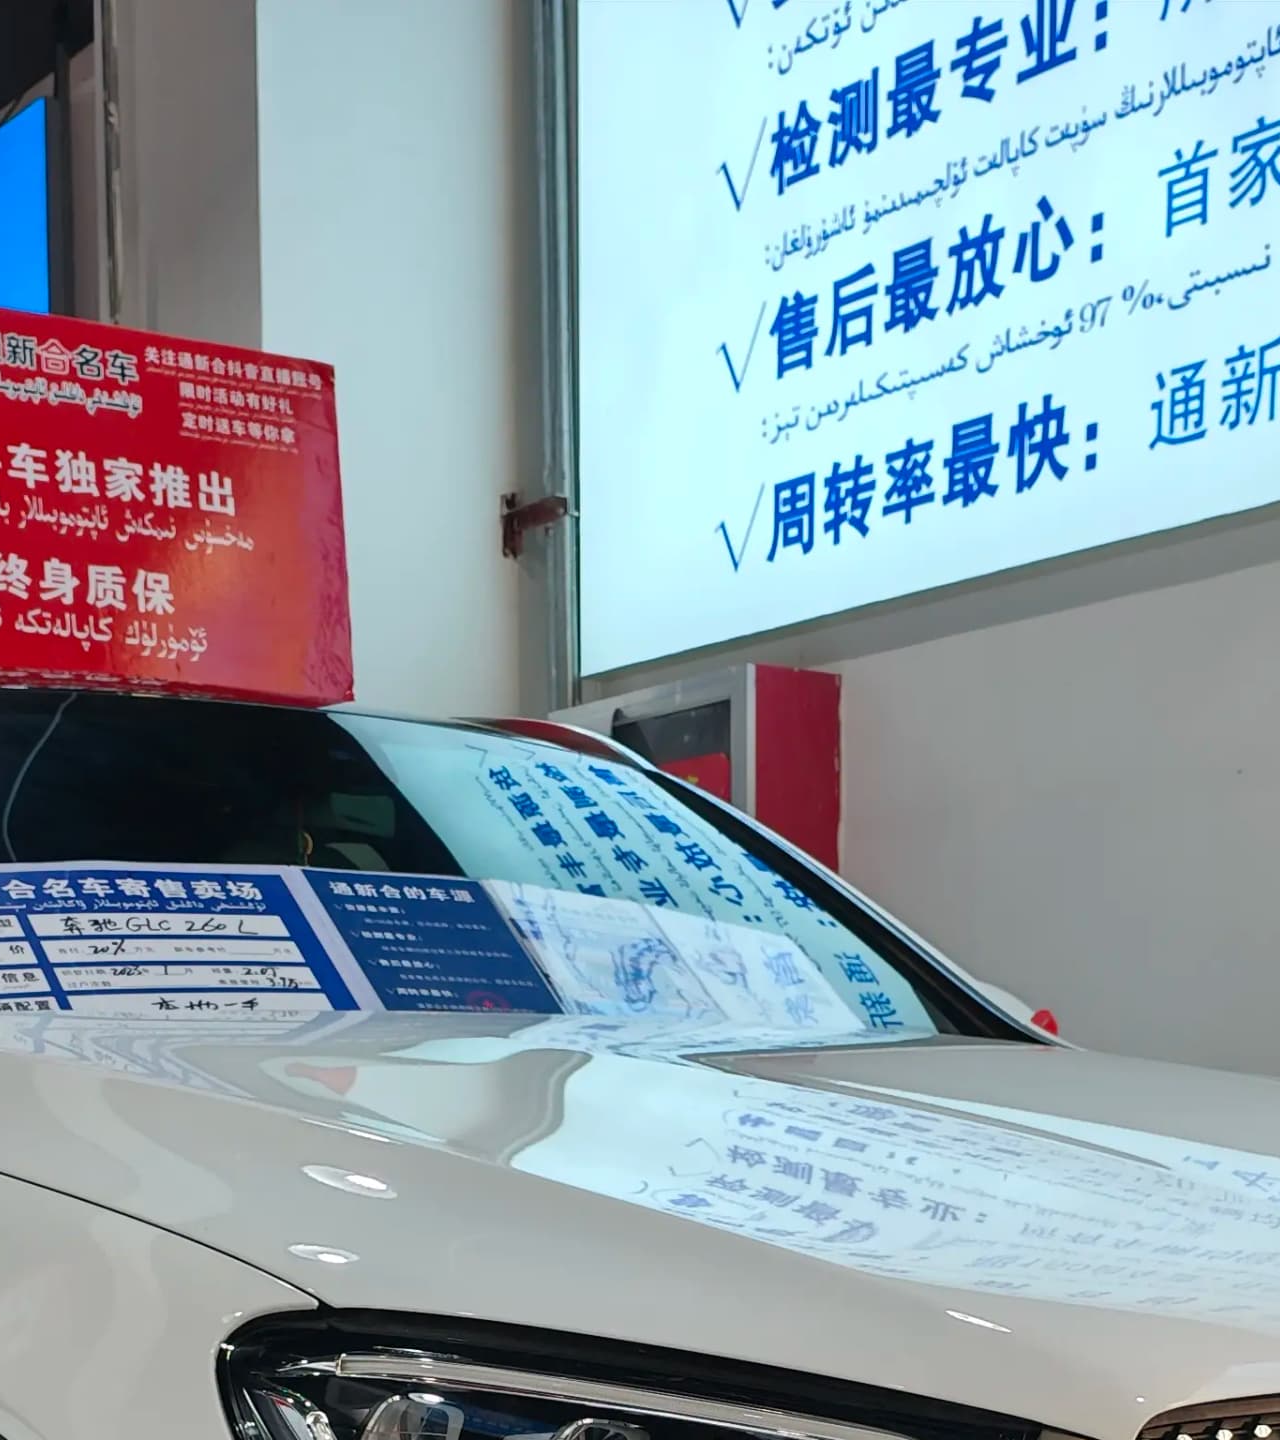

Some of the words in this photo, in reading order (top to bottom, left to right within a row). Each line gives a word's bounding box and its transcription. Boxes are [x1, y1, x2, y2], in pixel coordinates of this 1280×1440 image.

[769, 196, 1104, 379] 售后最放心：
[767, 393, 1099, 562] 周转率最快：
